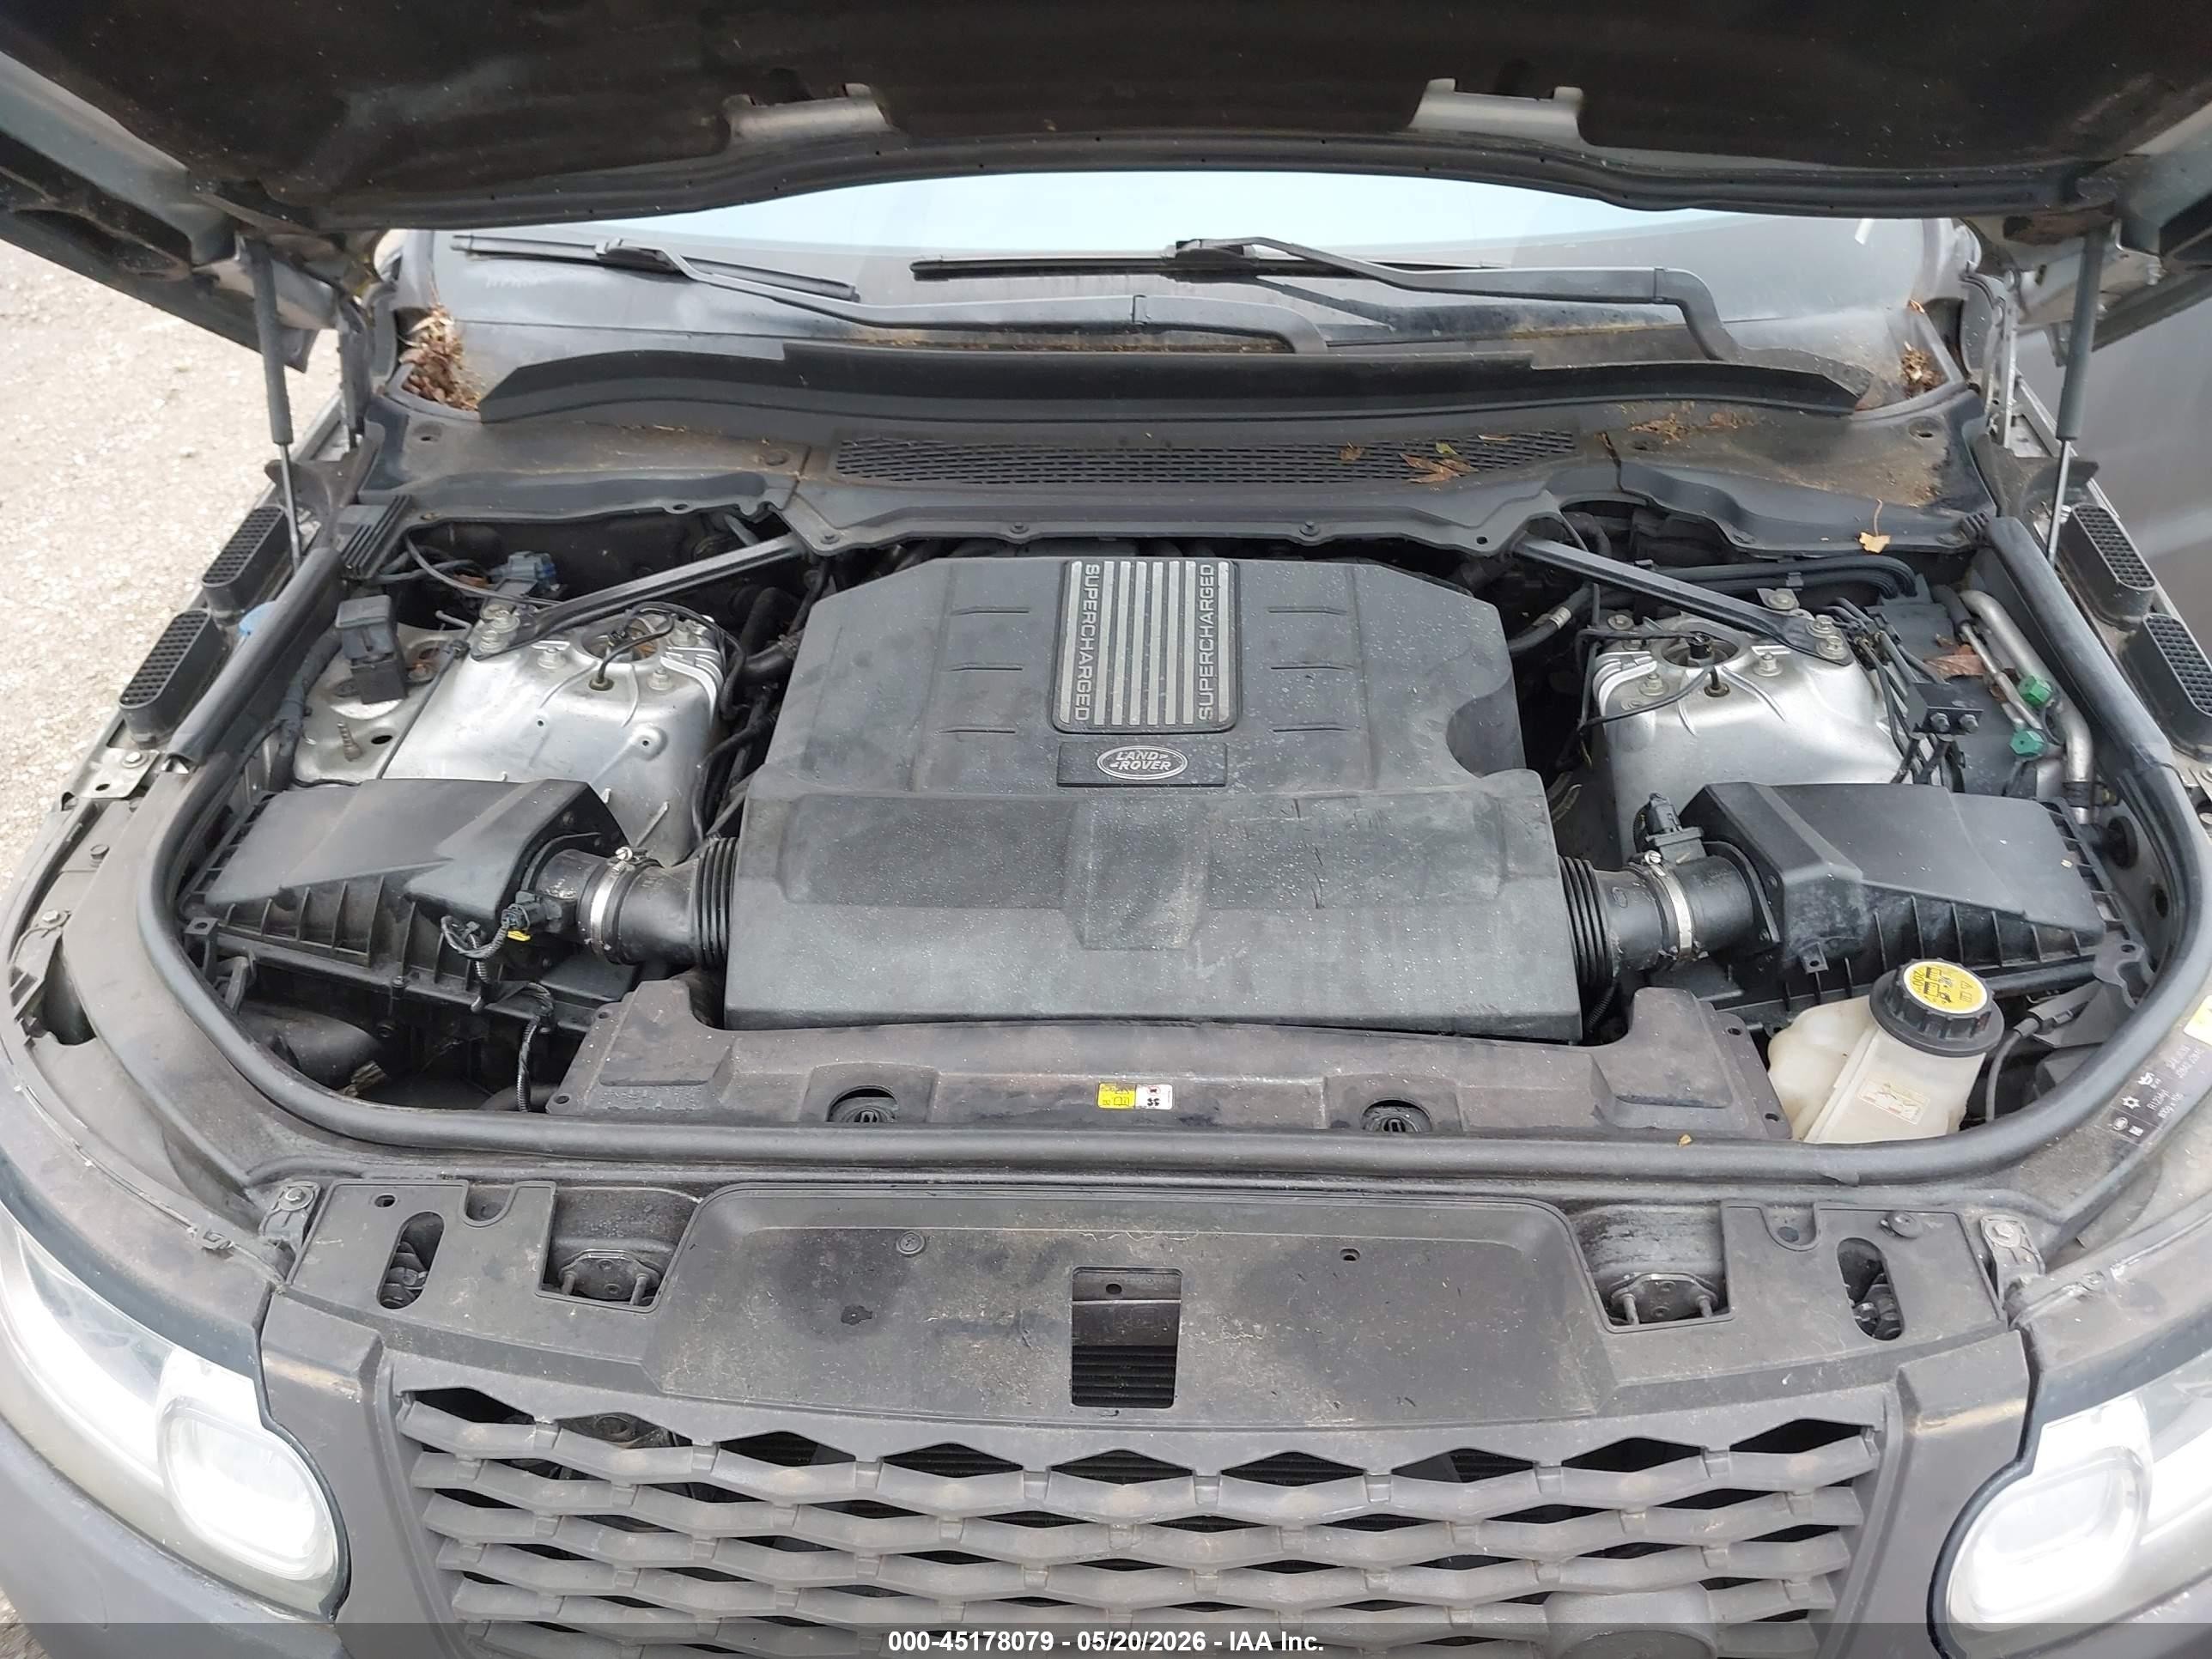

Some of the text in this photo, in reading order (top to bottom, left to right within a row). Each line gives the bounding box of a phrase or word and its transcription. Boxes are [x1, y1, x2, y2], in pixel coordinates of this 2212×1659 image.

[1074, 563, 1100, 721] SUPERCHARGED
[1198, 563, 1215, 721] SUPERCHARGED
[1116, 751, 1159, 761] LAND
[1118, 760, 1171, 770] ROVER
